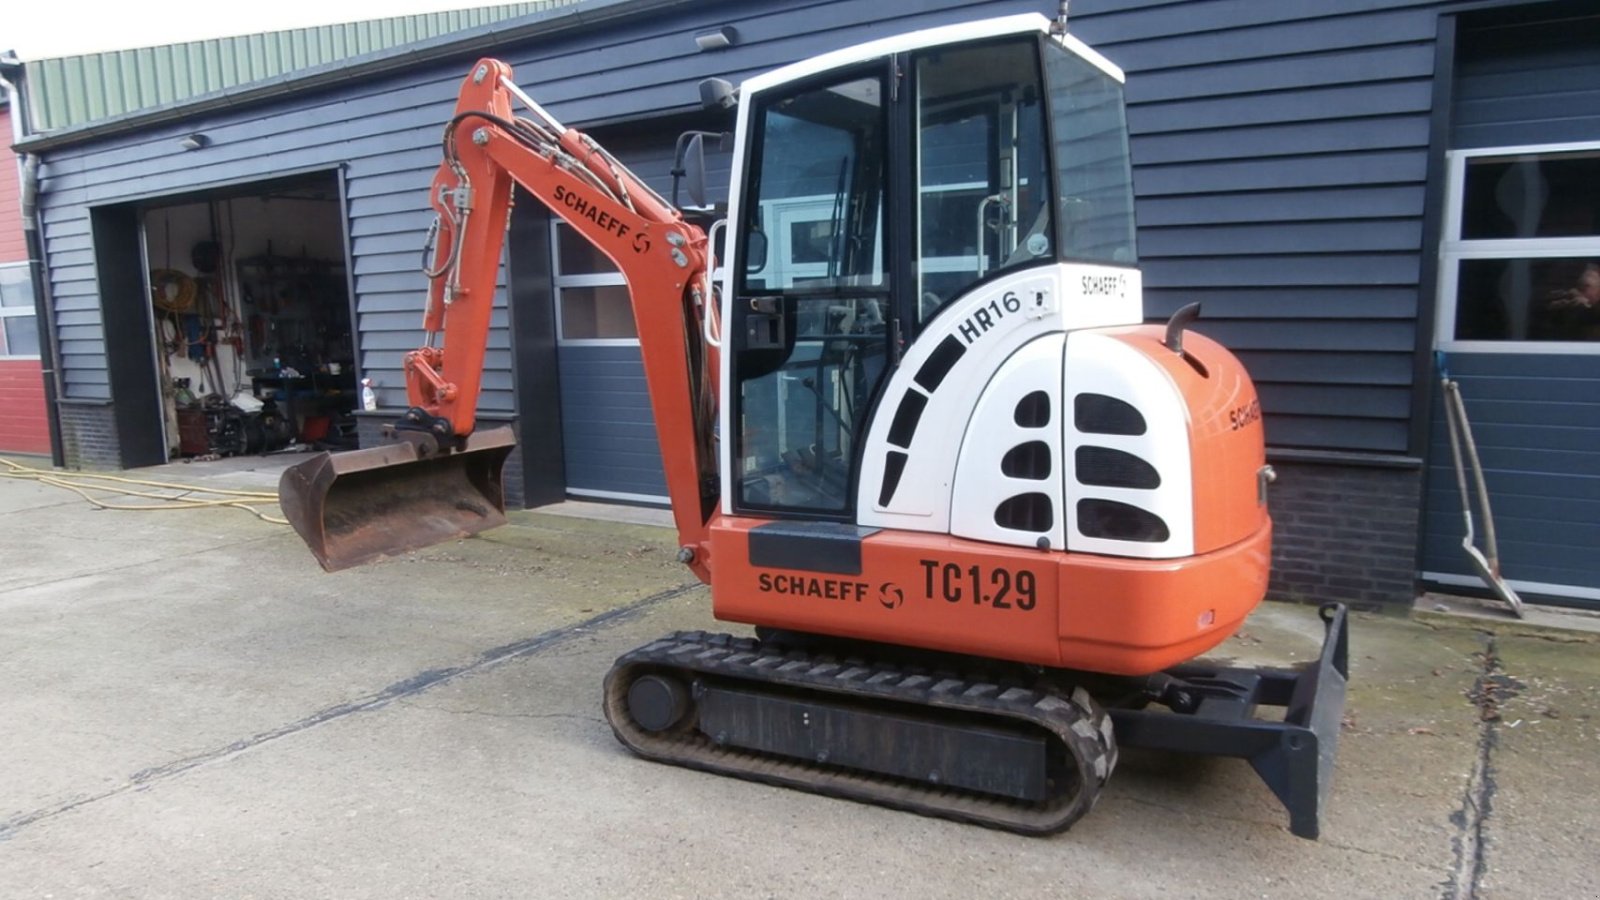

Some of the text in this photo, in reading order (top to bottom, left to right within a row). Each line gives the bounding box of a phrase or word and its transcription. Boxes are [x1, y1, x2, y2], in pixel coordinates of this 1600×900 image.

[553, 185, 630, 238] SCHAEFF
[1082, 275, 1117, 296] SCHAEFF
[958, 291, 1021, 344] HR16
[759, 573, 869, 602] SCHAEFF
